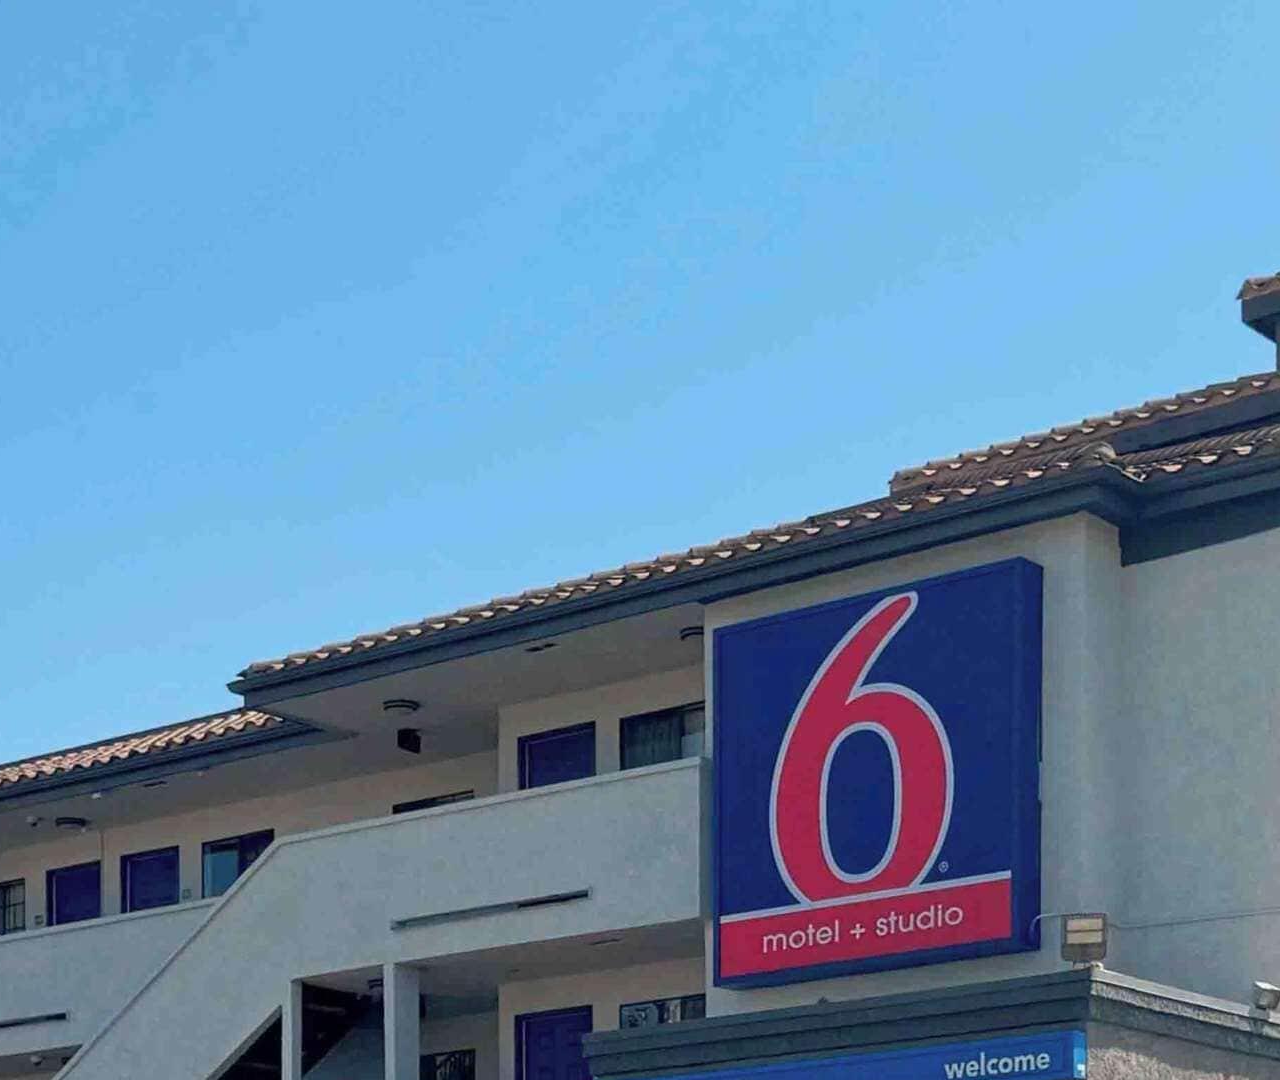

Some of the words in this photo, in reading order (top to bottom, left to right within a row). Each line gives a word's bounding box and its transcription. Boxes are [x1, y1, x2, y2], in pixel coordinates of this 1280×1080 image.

[769, 590, 954, 905] 6
[762, 919, 840, 953] motel
[876, 904, 964, 936] studio
[944, 1051, 1051, 1080] welcome
